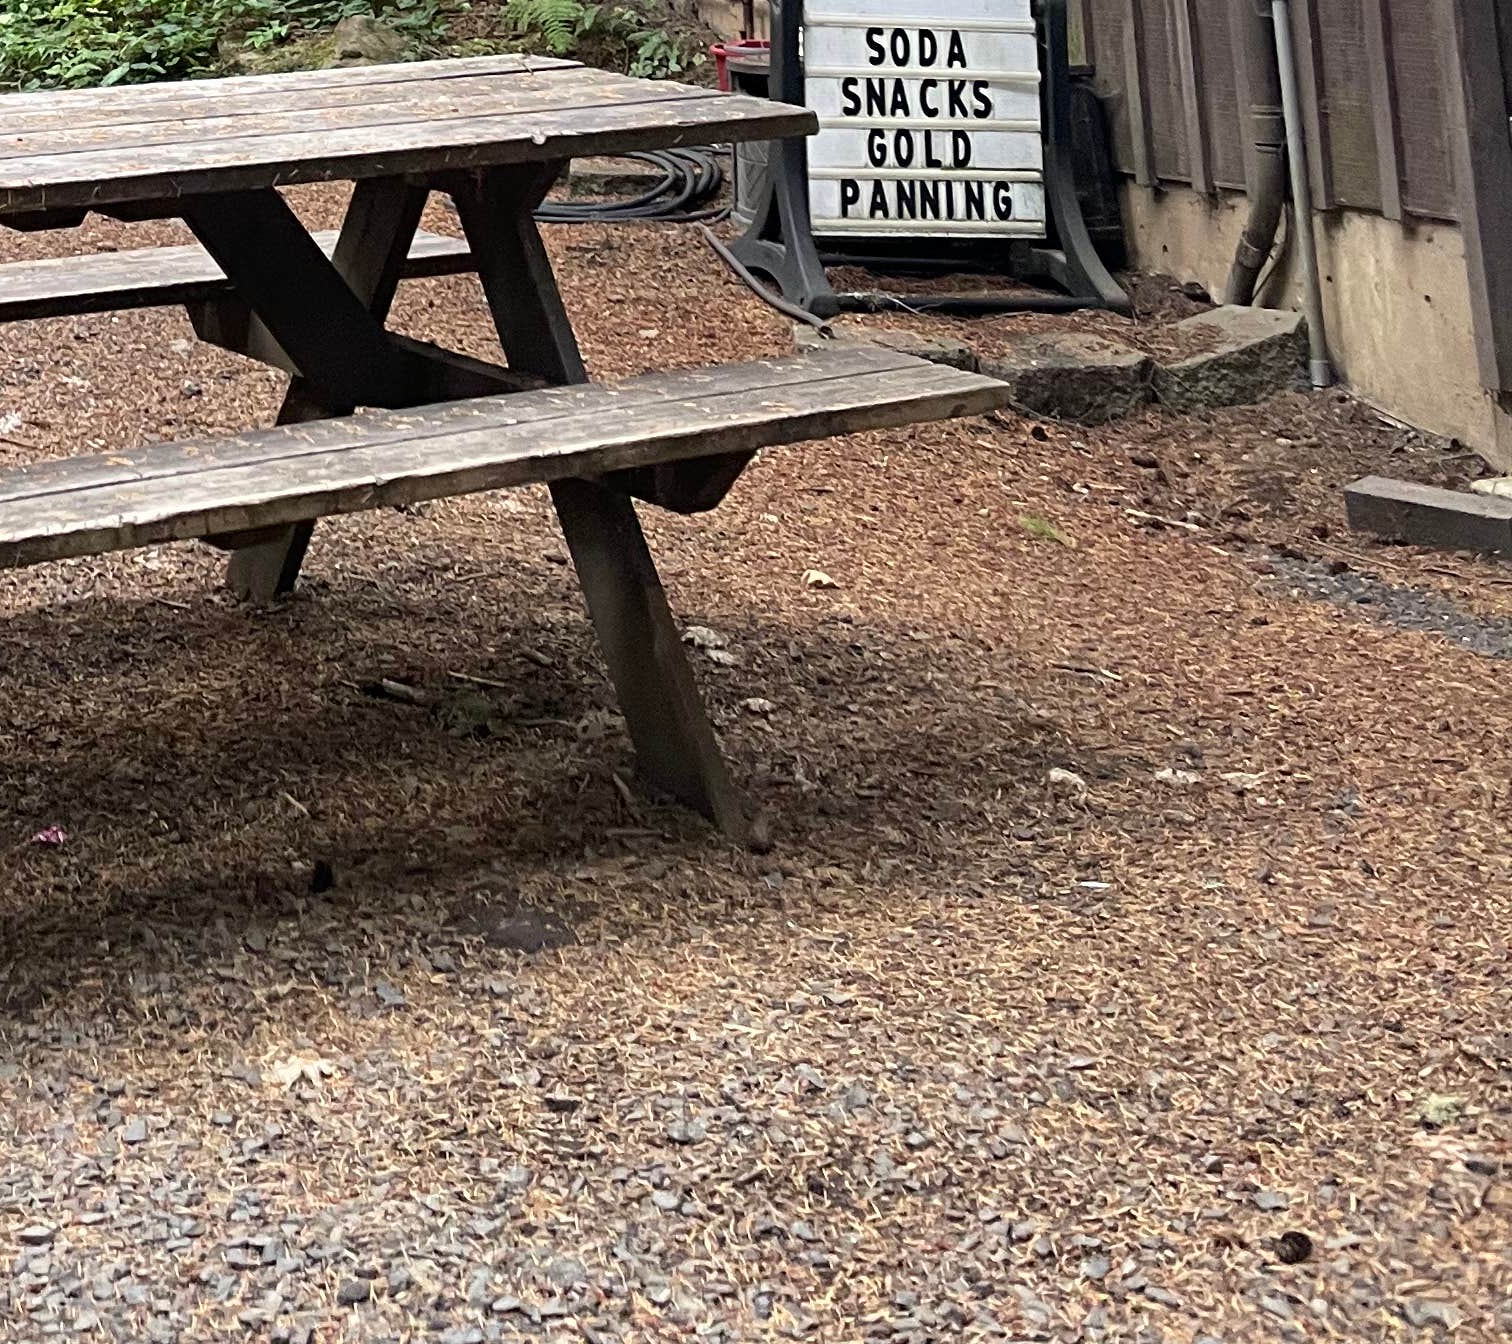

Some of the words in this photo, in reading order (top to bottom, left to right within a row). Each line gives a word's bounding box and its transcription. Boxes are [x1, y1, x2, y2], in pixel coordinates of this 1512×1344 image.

[865, 26, 967, 69] SODA
[841, 76, 993, 119] SNACKS
[867, 127, 972, 169] GOLD
[840, 178, 1012, 222] PANNING
